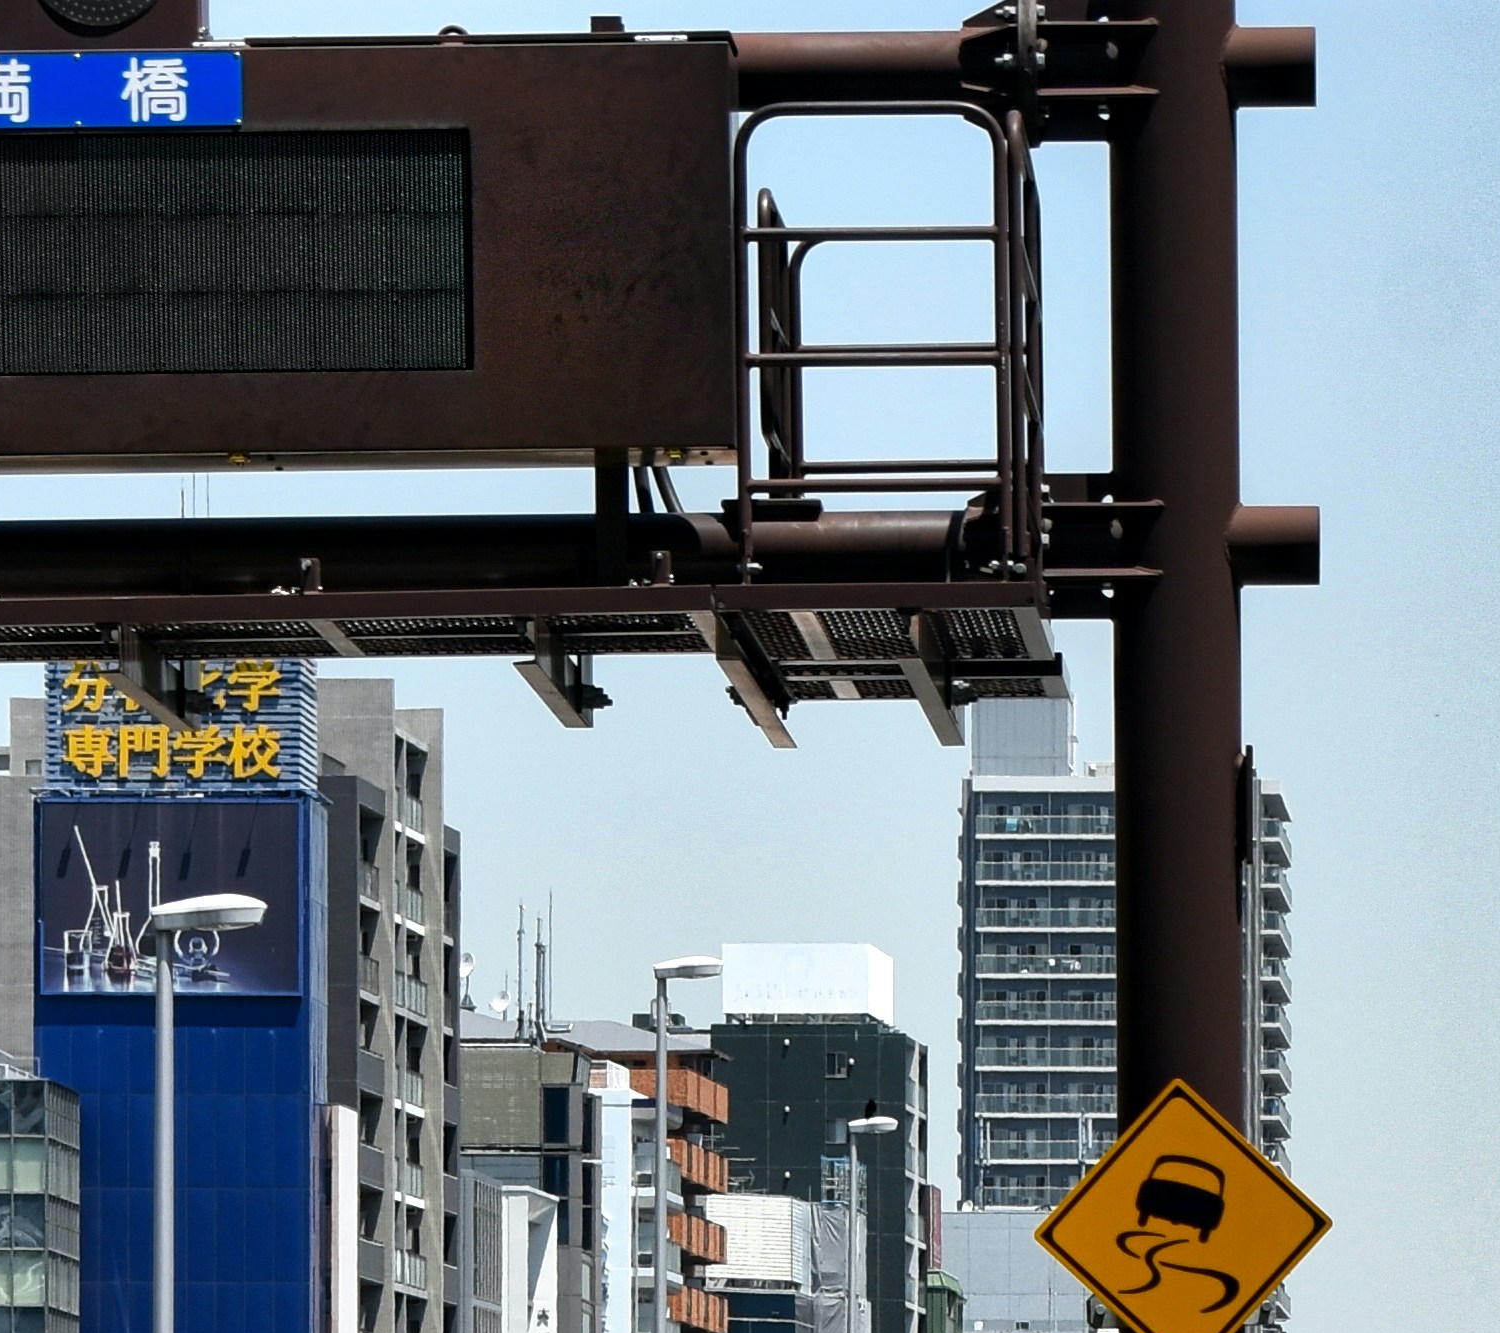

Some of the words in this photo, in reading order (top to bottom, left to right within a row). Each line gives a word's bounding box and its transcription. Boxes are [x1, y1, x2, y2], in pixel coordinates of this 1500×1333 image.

[63, 659, 282, 712] 分学
[63, 723, 282, 779] 専門学校
